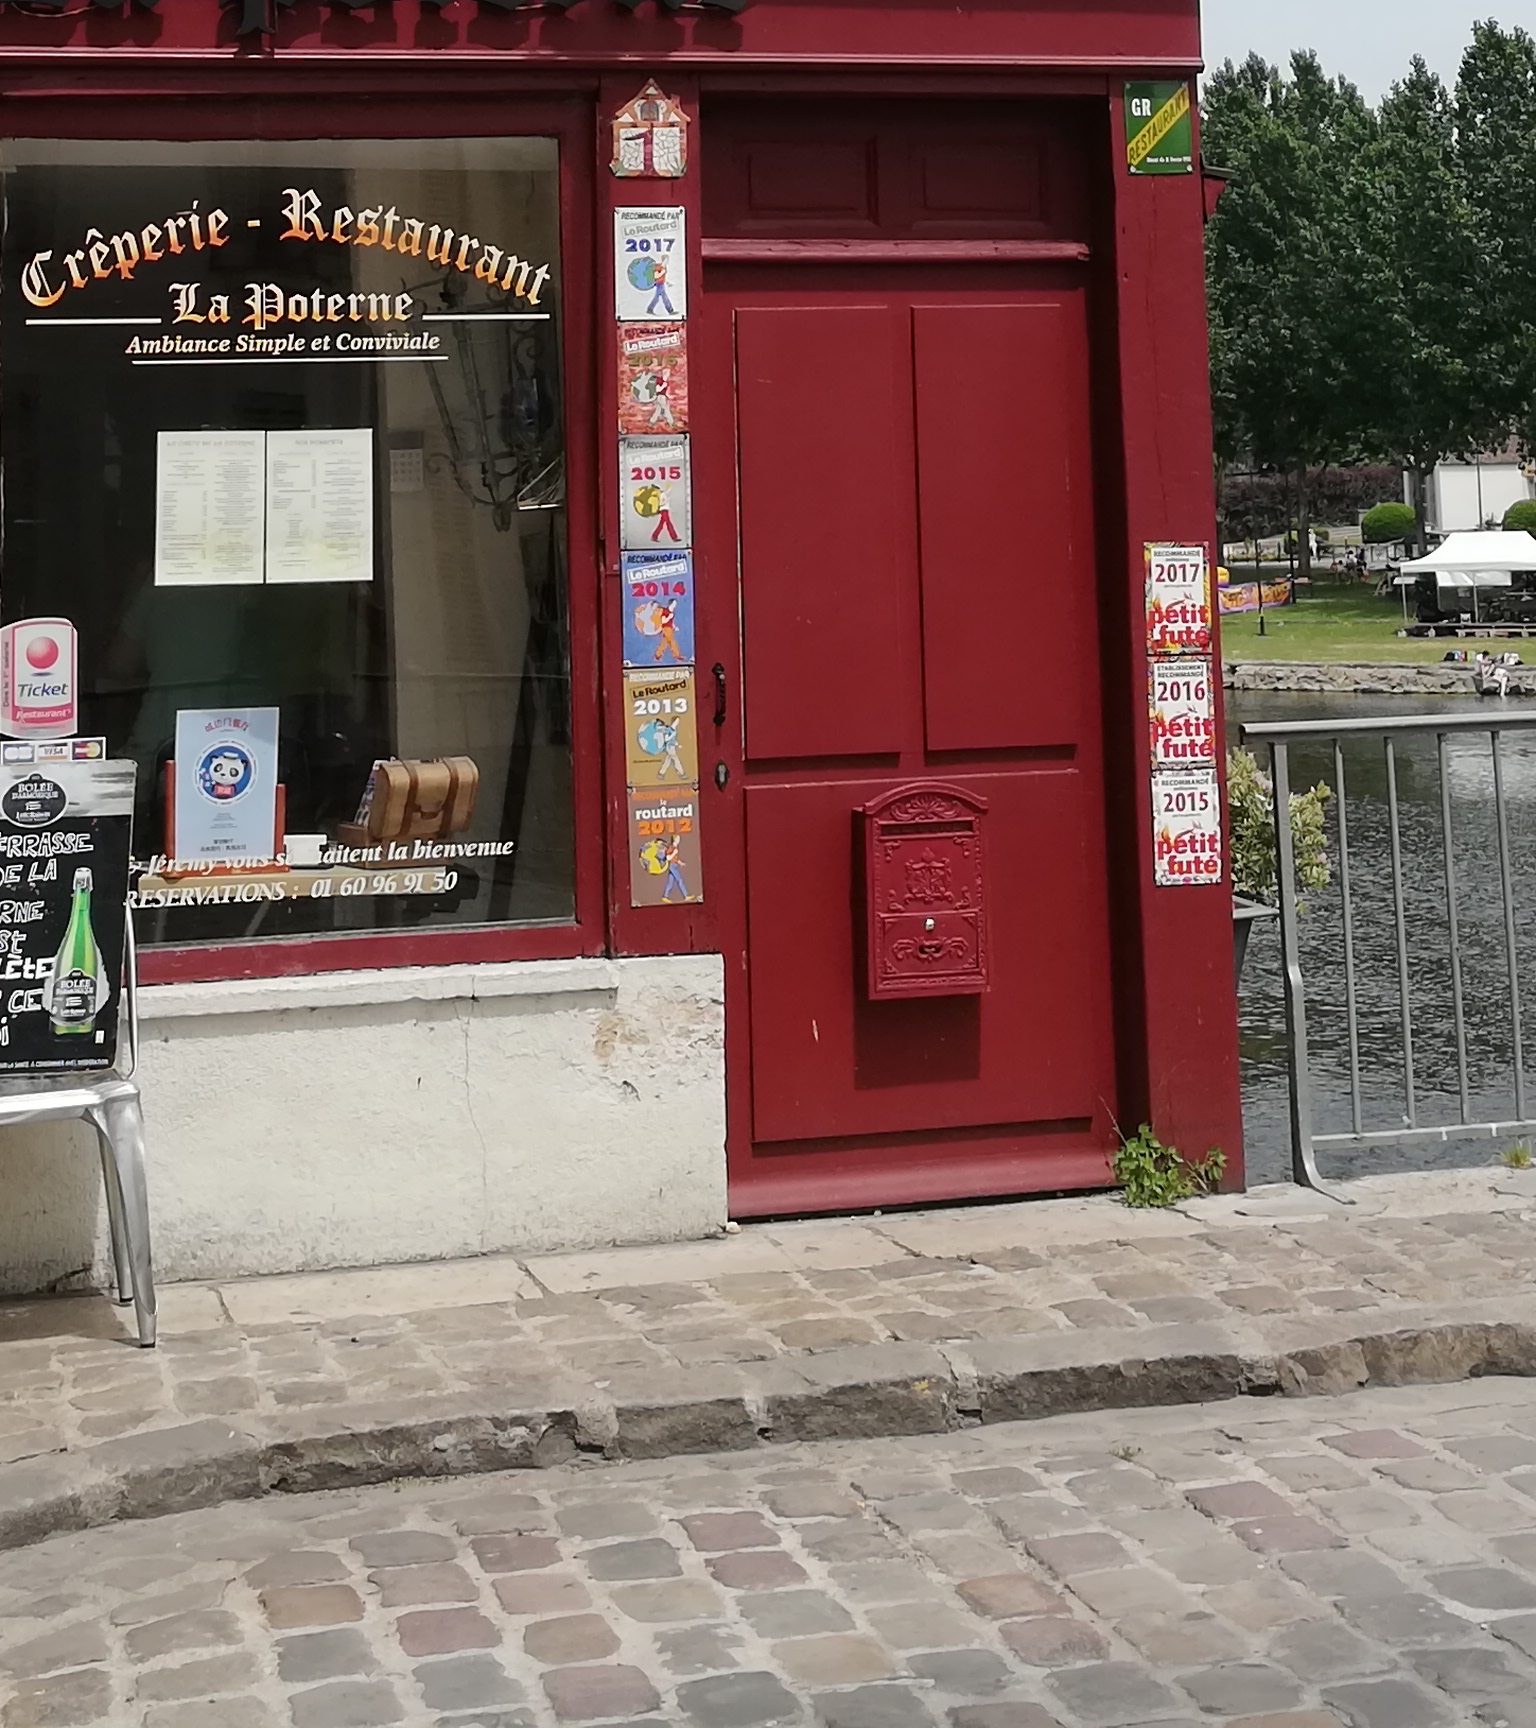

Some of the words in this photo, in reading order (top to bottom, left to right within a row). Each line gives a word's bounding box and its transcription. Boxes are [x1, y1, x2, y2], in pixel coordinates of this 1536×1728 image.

[1131, 98, 1152, 117] GR
[1129, 89, 1189, 162] RESTAURANT
[637, 220, 677, 234] Routard
[21, 200, 231, 308] Crêperie
[279, 187, 551, 305] Restaurant
[625, 238, 676, 253] 2017
[168, 283, 232, 324] La
[241, 282, 414, 330] Poterne
[125, 334, 231, 355] Ambiance
[235, 332, 312, 356] Simple
[314, 335, 332, 352] et
[336, 331, 441, 352] Conviviale
[639, 334, 678, 350] Routard
[627, 354, 679, 367] 2016
[631, 466, 681, 480] 2015
[643, 562, 685, 577] Routard
[1155, 563, 1200, 583] 2017
[632, 581, 686, 597] 2014
[1148, 603, 1211, 630] petit
[1158, 625, 1210, 646] futé
[18, 682, 68, 698] Ticket
[633, 690, 644, 698] Le
[645, 679, 686, 696] Routard
[1157, 681, 1206, 702] 2016
[633, 697, 688, 715] 2013
[1151, 716, 1215, 743] petit
[43, 747, 64, 755] VISA
[1162, 738, 1214, 759] futé
[635, 803, 693, 821] routard
[1164, 792, 1209, 813] 2015
[639, 819, 693, 835] 2012
[387, 840, 409, 861] la
[413, 839, 514, 859] bienvenue
[1156, 832, 1218, 860] petit
[28, 859, 57, 882] LA
[1168, 856, 1218, 876] futé
[123, 882, 288, 909] RESERVATIONS
[311, 878, 332, 898] 01
[339, 876, 366, 897] 60
[372, 875, 398, 894] 96
[403, 873, 424, 893] 91
[431, 871, 458, 892] 50
